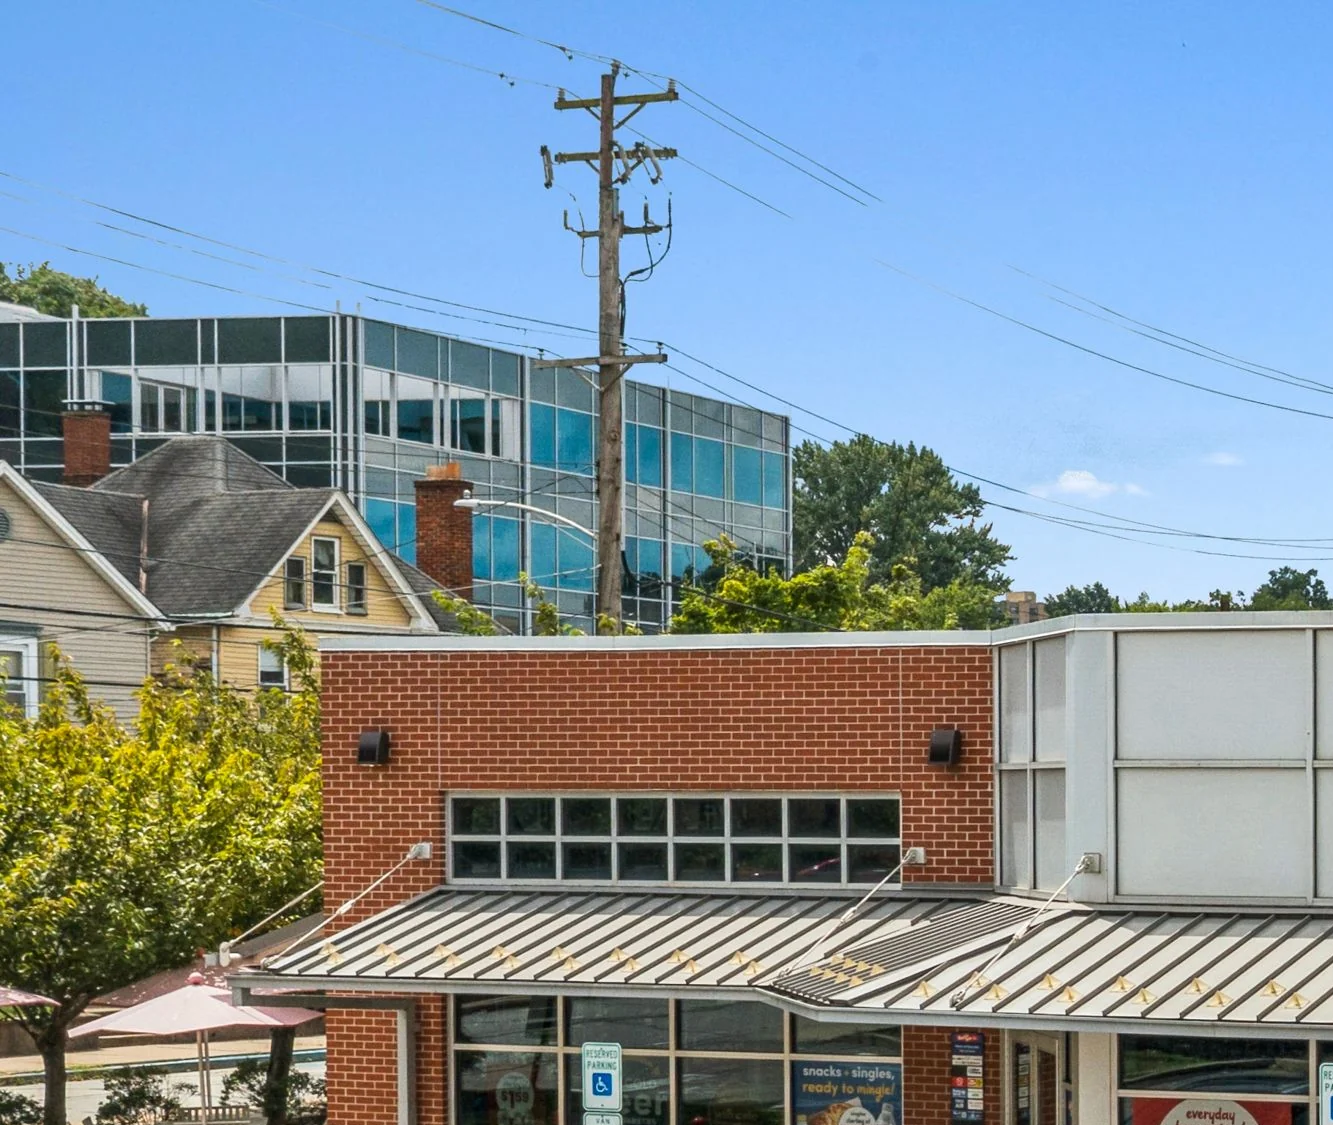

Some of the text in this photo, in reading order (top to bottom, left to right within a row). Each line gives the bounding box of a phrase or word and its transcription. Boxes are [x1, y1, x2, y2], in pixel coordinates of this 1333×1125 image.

[585, 1049, 618, 1059] RESERVED
[587, 1061, 617, 1070] PARKING
[802, 1066, 841, 1077] snacks
[851, 1066, 895, 1080] singles,
[802, 1081, 838, 1096] ready
[842, 1084, 853, 1094] to
[1185, 1108, 1236, 1125] everyday
